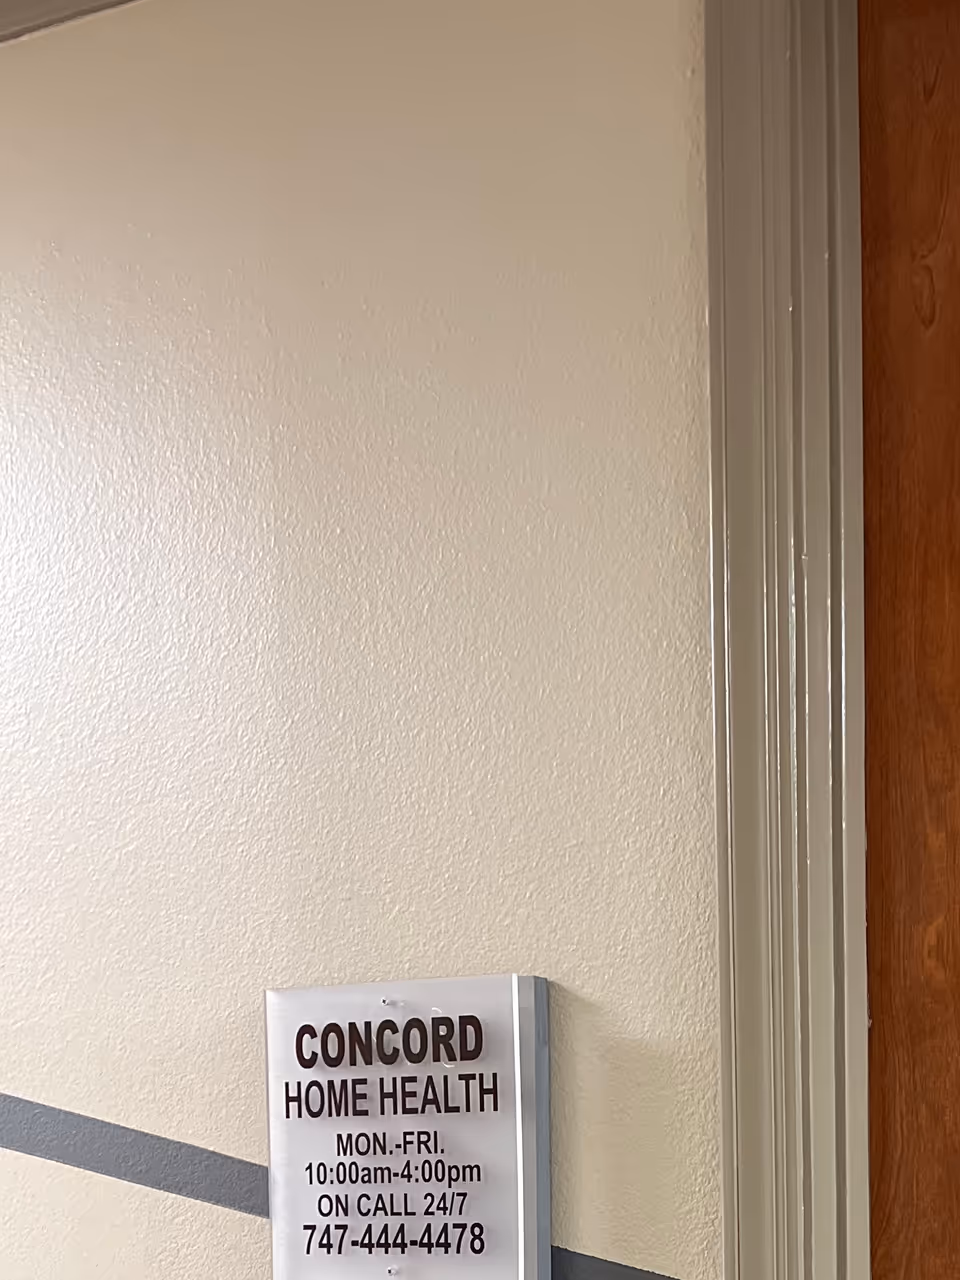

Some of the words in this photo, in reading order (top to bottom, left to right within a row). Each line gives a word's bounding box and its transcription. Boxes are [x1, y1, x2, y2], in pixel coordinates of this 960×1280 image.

[295, 1015, 483, 1069] CONCORD
[284, 1078, 369, 1119] HOME
[380, 1073, 499, 1116] HEALTH
[336, 1131, 445, 1157] MON.-FRI.
[305, 1160, 481, 1188] 10:00am-4:00pm
[317, 1194, 349, 1217] ON
[357, 1193, 416, 1217] CALL
[423, 1192, 468, 1216] 24/7
[303, 1223, 485, 1255] 747-444-4478
